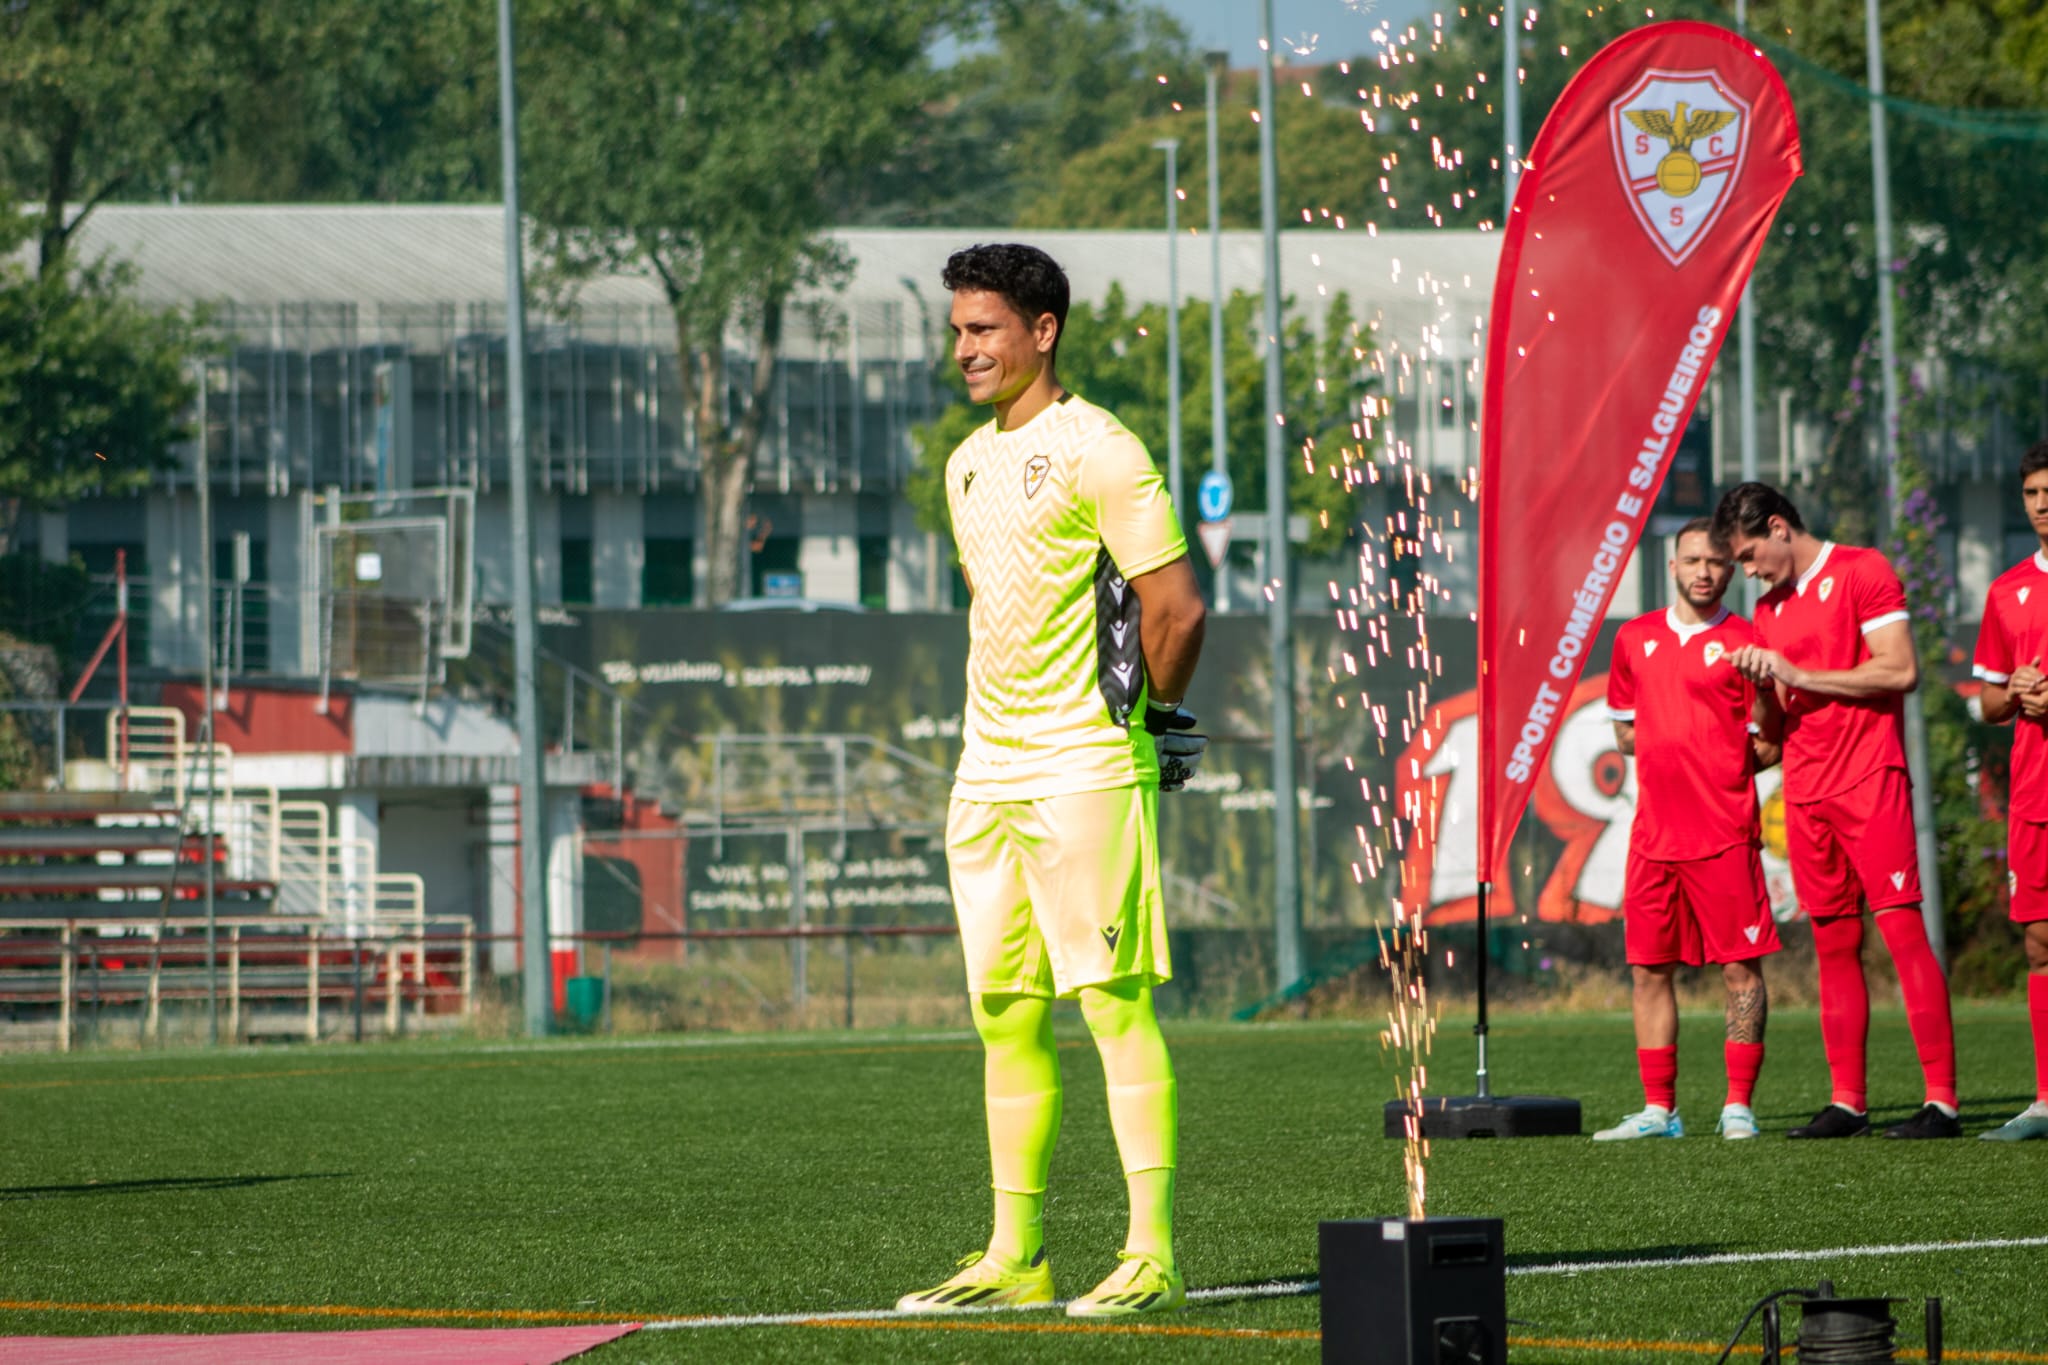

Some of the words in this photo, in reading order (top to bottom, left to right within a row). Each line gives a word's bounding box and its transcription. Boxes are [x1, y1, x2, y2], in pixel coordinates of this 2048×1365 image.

[1635, 134, 1650, 155] S
[1708, 136, 1723, 156] C
[1669, 206, 1684, 227] S
[1628, 304, 1722, 491] SALGUEIROS
[1616, 491, 1643, 519] E
[1549, 521, 1629, 679] COMÉRCIO
[1505, 681, 1562, 784] SPORT
